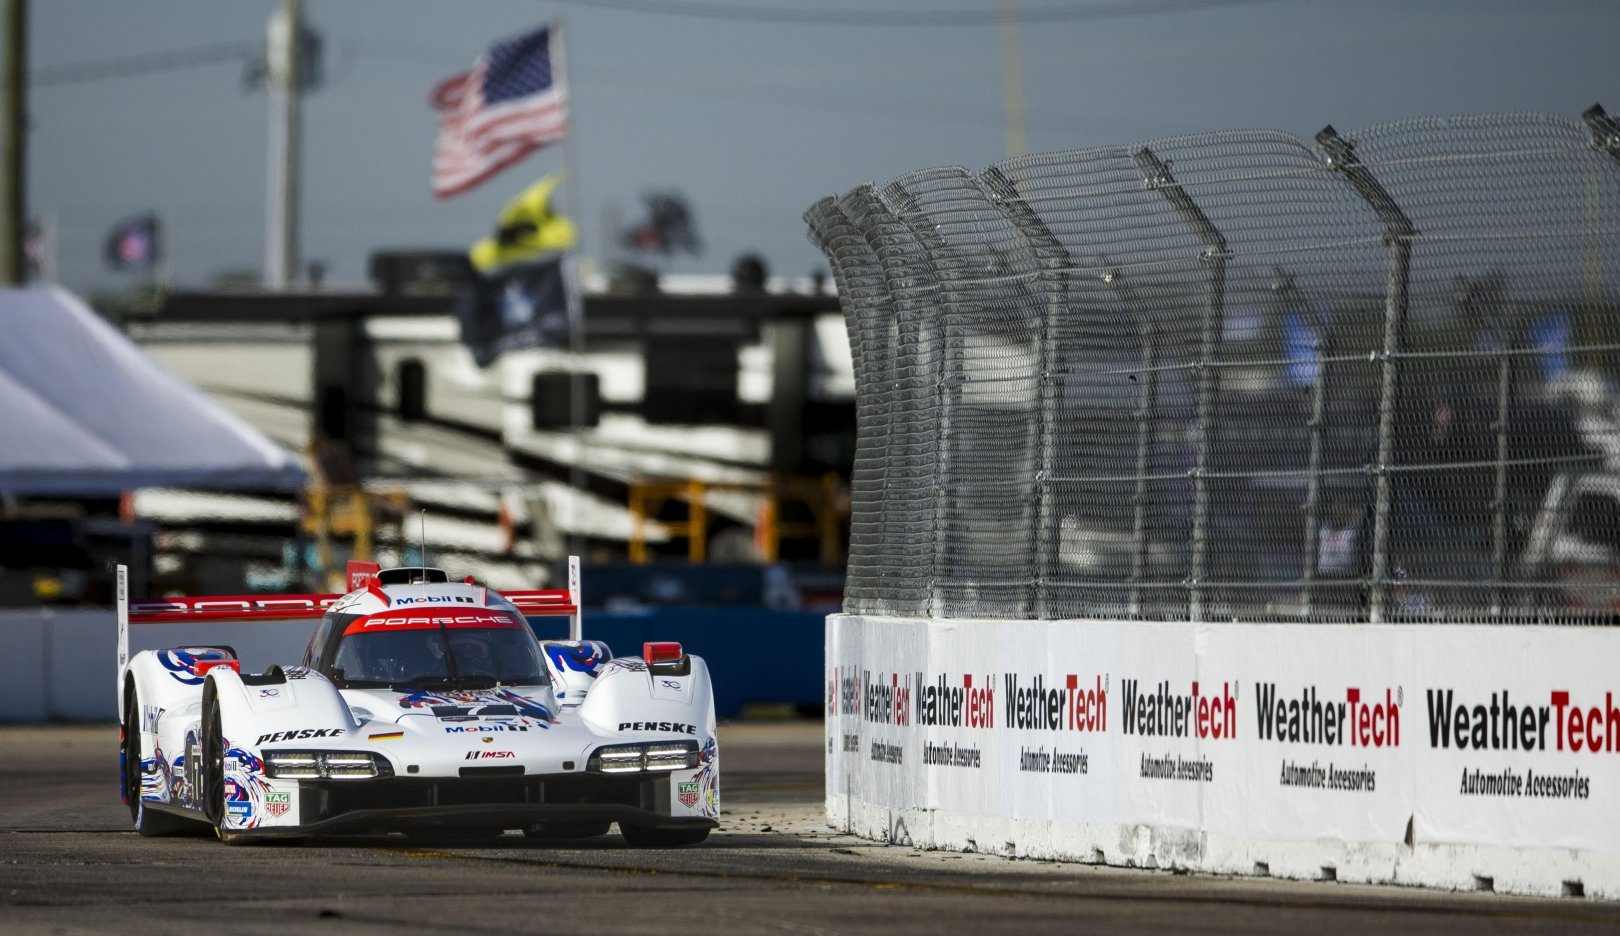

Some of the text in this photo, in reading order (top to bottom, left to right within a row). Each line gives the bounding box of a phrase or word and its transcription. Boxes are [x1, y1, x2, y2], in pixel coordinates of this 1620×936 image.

[396, 596, 451, 605] Mobil
[364, 616, 514, 628] PORSCHE
[445, 725, 504, 733] Mobil
[618, 722, 697, 735] PENSKE
[255, 729, 346, 746] PENSKE
[481, 751, 516, 759] IMSA
[1020, 746, 1088, 774] Automotive Accessories
[1140, 752, 1176, 779] Automotive
[1280, 759, 1376, 792] Automotive Accessories
[680, 784, 698, 793] TAG
[1460, 767, 1590, 800] Automotive Accessories
[266, 794, 288, 803] TAG
[266, 803, 288, 816] HEUER
